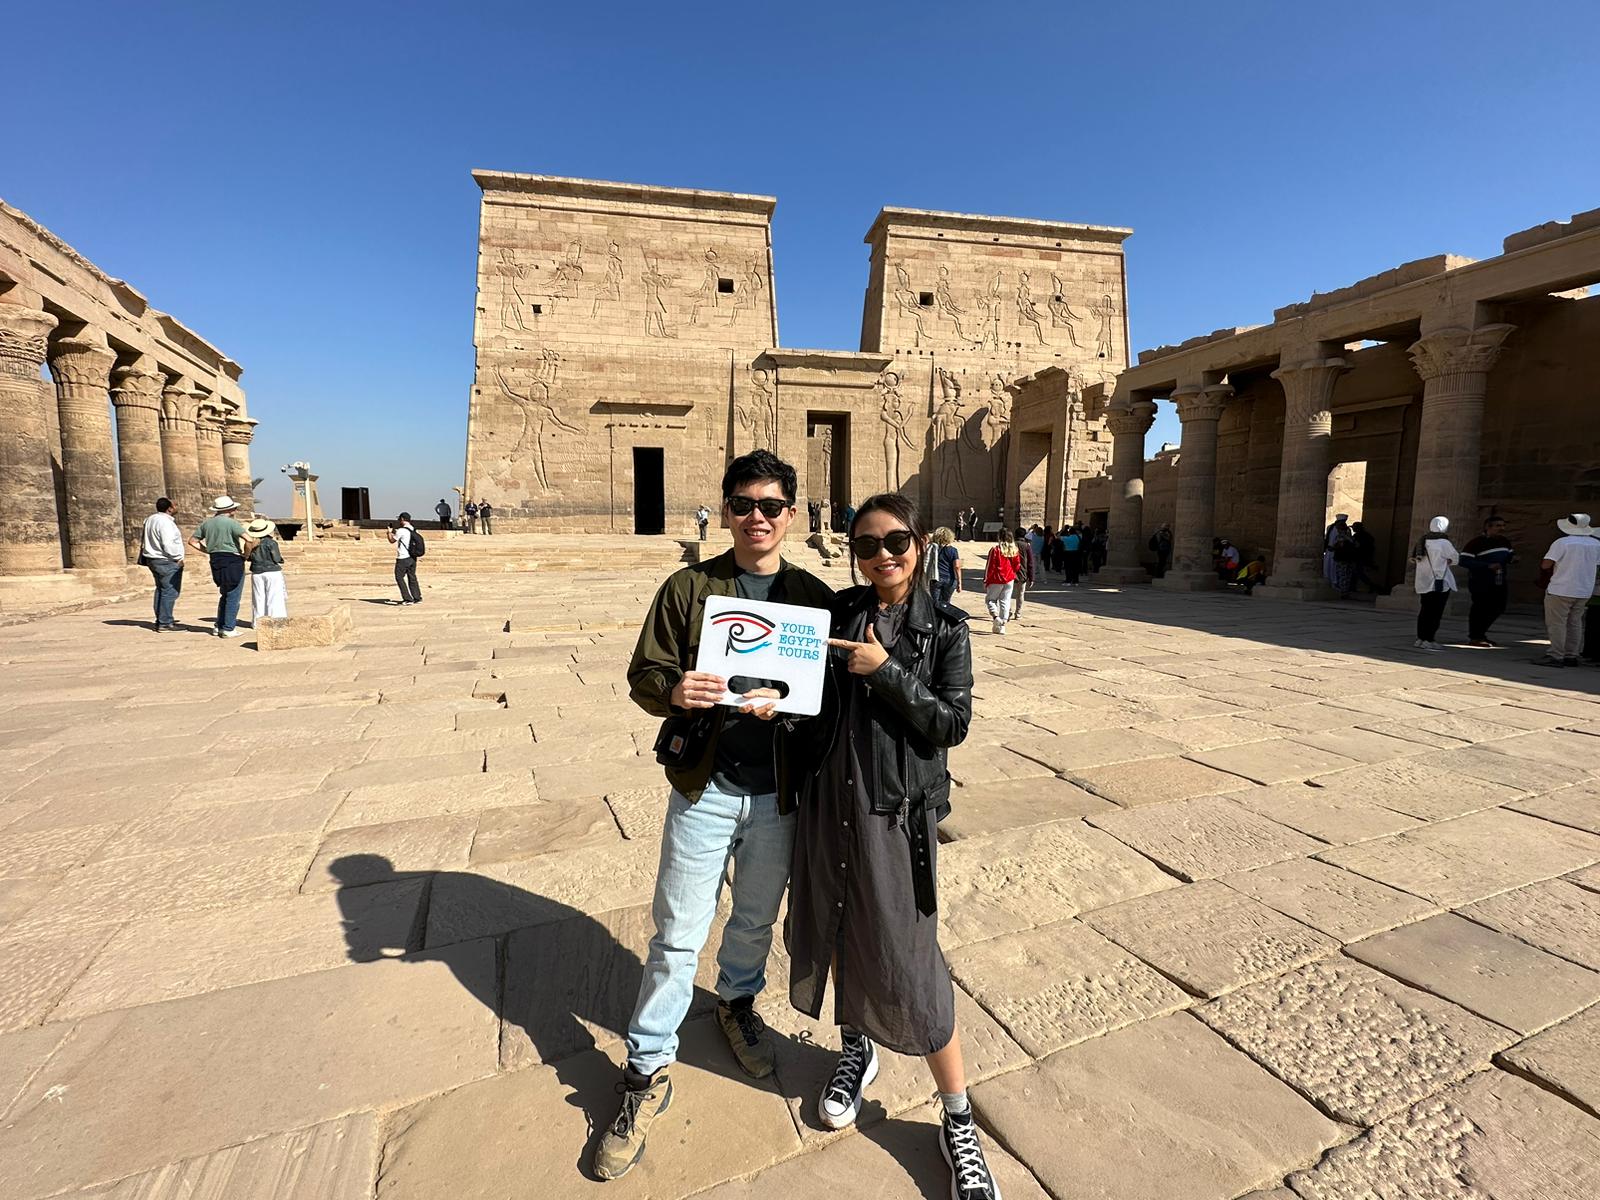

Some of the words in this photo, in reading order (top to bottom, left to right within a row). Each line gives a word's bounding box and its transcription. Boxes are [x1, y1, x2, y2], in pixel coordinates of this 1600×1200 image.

[781, 622, 816, 635] YOUR
[779, 634, 821, 648] EGYPT
[778, 646, 820, 660] TOURS
